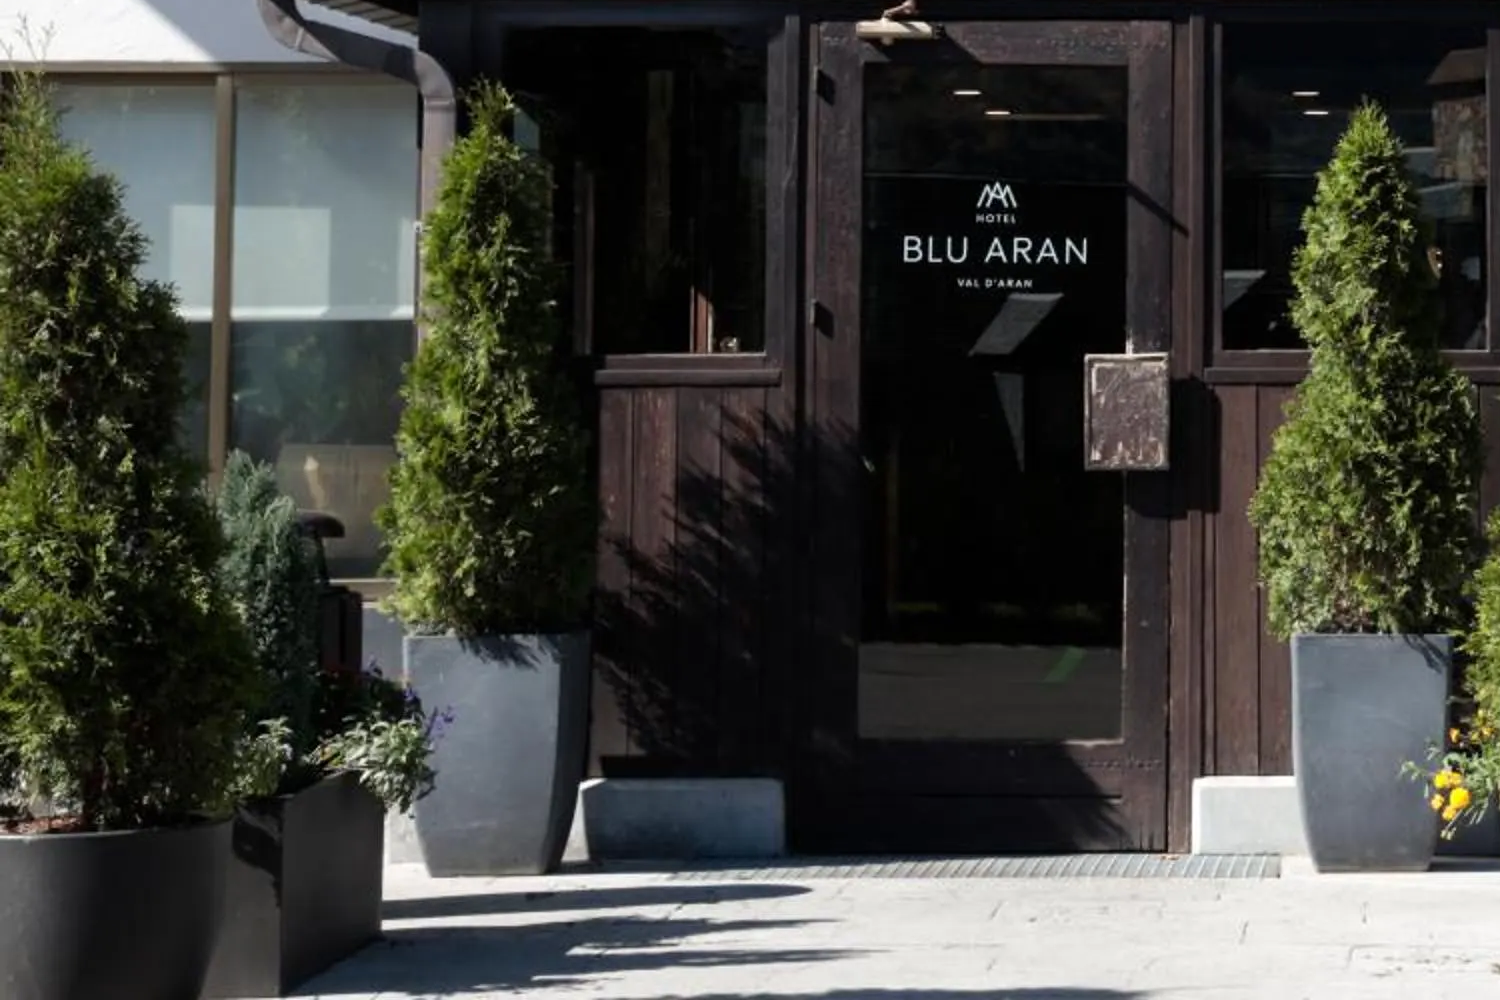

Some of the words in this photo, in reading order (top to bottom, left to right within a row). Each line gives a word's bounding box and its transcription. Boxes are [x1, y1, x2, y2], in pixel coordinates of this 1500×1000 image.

[975, 213, 1017, 225] HOTEL
[903, 235, 968, 264] BLU
[984, 237, 1088, 265] ARAN
[956, 277, 980, 288] VAL
[985, 277, 1033, 289] D'ARAN
